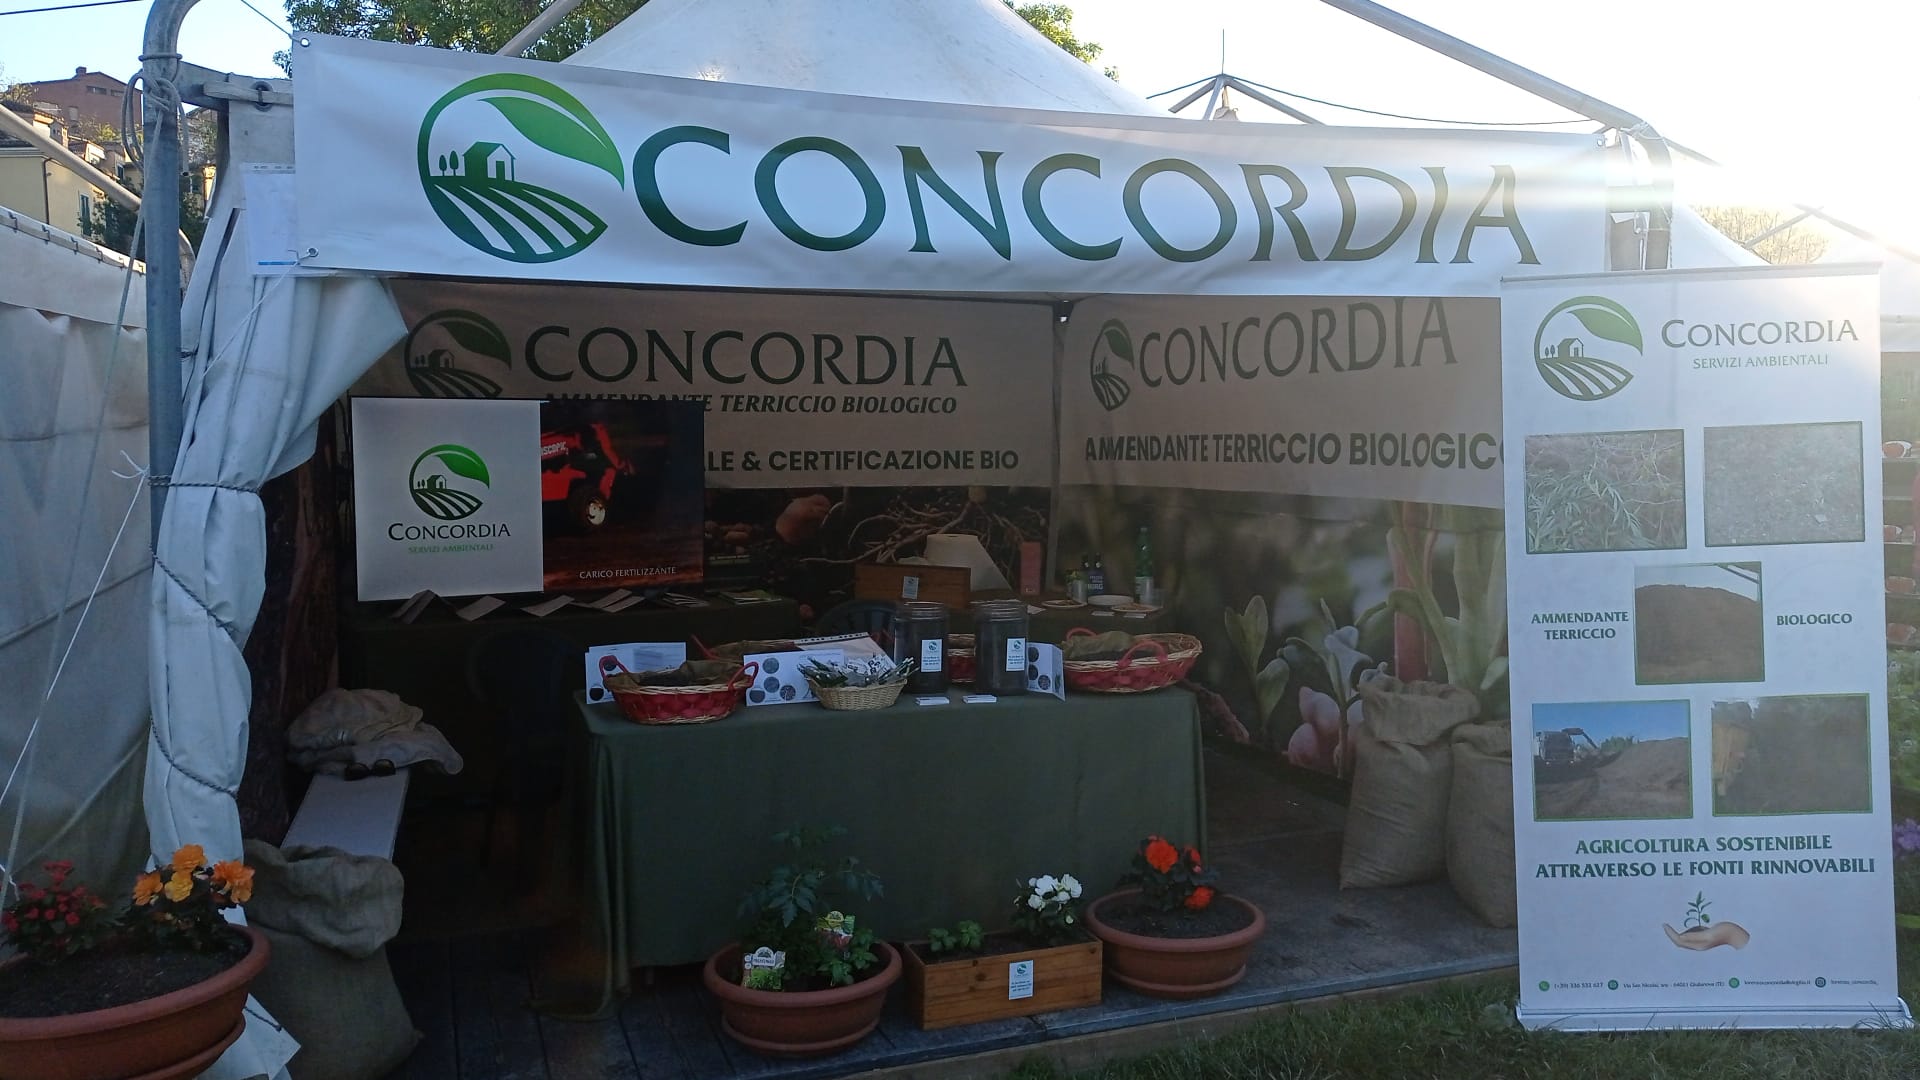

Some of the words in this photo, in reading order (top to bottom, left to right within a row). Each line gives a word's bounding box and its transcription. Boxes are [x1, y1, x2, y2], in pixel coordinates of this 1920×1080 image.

[632, 124, 1542, 266] CONCORDIA
[1138, 296, 1459, 388] CONCORDIA
[1661, 318, 1859, 349] CONCORDIA
[525, 325, 968, 387] CONCORDIA
[1692, 355, 1742, 370] SERVIZI
[1744, 352, 1829, 368] AMBIENTALI
[719, 394, 837, 414] TERRICCIO
[841, 396, 958, 414] BIOLOGICO
[741, 450, 762, 472] &
[768, 449, 974, 472] CERTIFICAZIONE
[980, 449, 1020, 470] BIO
[1212, 432, 1342, 464] TERRICCIO
[1349, 431, 1505, 470] BIOLOGIC
[387, 522, 512, 542] CONCORDIA
[408, 545, 440, 555] SERVIZI
[442, 543, 494, 554] AMBIENTALI
[579, 568, 613, 579] CARICO
[615, 565, 677, 578] FERTILIZZANTE
[1531, 611, 1629, 625] AMMENDANTE
[1776, 612, 1853, 626] BIOLOGICO
[1544, 627, 1617, 641] TERRICCIO
[1575, 837, 1710, 855] AGRICOLTURA
[1716, 834, 1833, 852] SOSTENIBILE
[1535, 862, 1657, 879] ATTRAVERSO
[1663, 861, 1684, 877] LE
[1689, 860, 1744, 876] FONTI
[1750, 857, 1876, 875] RINNOVABILI
